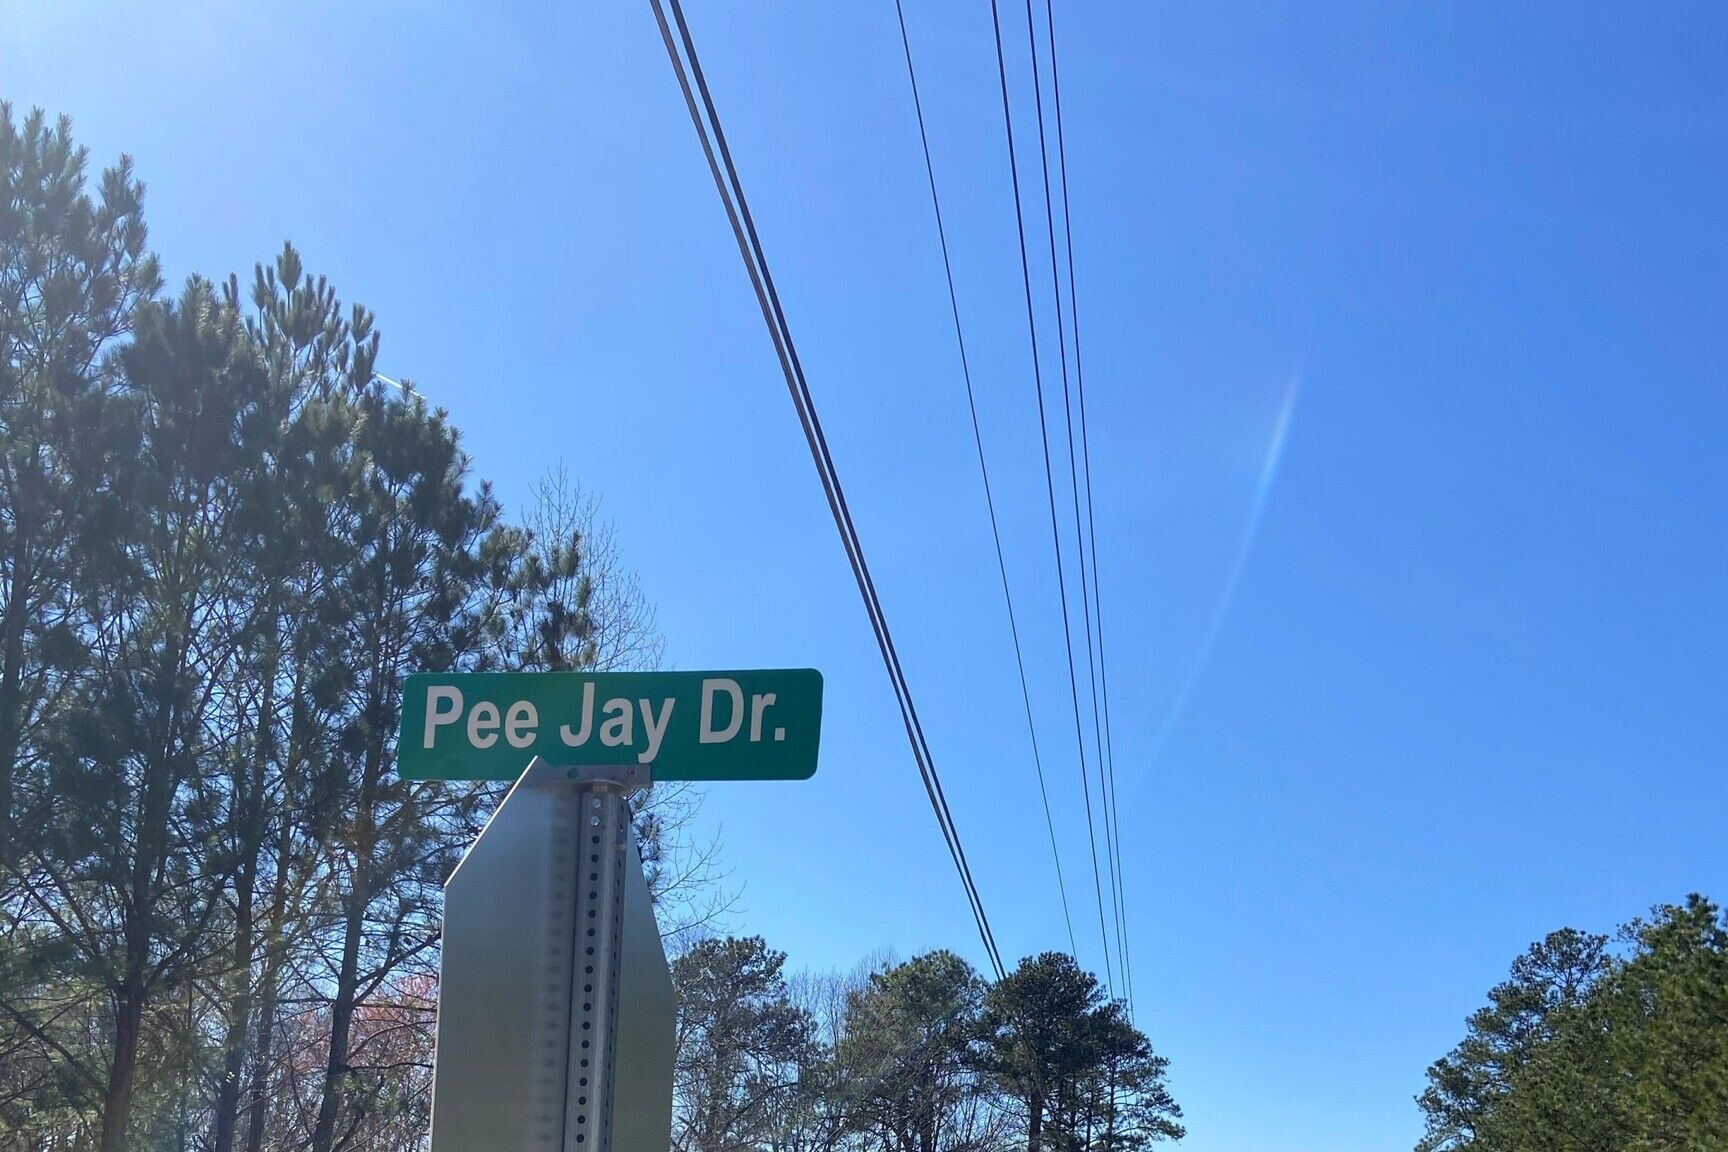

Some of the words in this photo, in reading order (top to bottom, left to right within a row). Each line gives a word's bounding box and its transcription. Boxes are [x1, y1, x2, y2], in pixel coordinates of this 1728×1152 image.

[423, 685, 539, 750] Pee
[560, 681, 676, 764] Jay
[699, 677, 786, 744] Dr.
